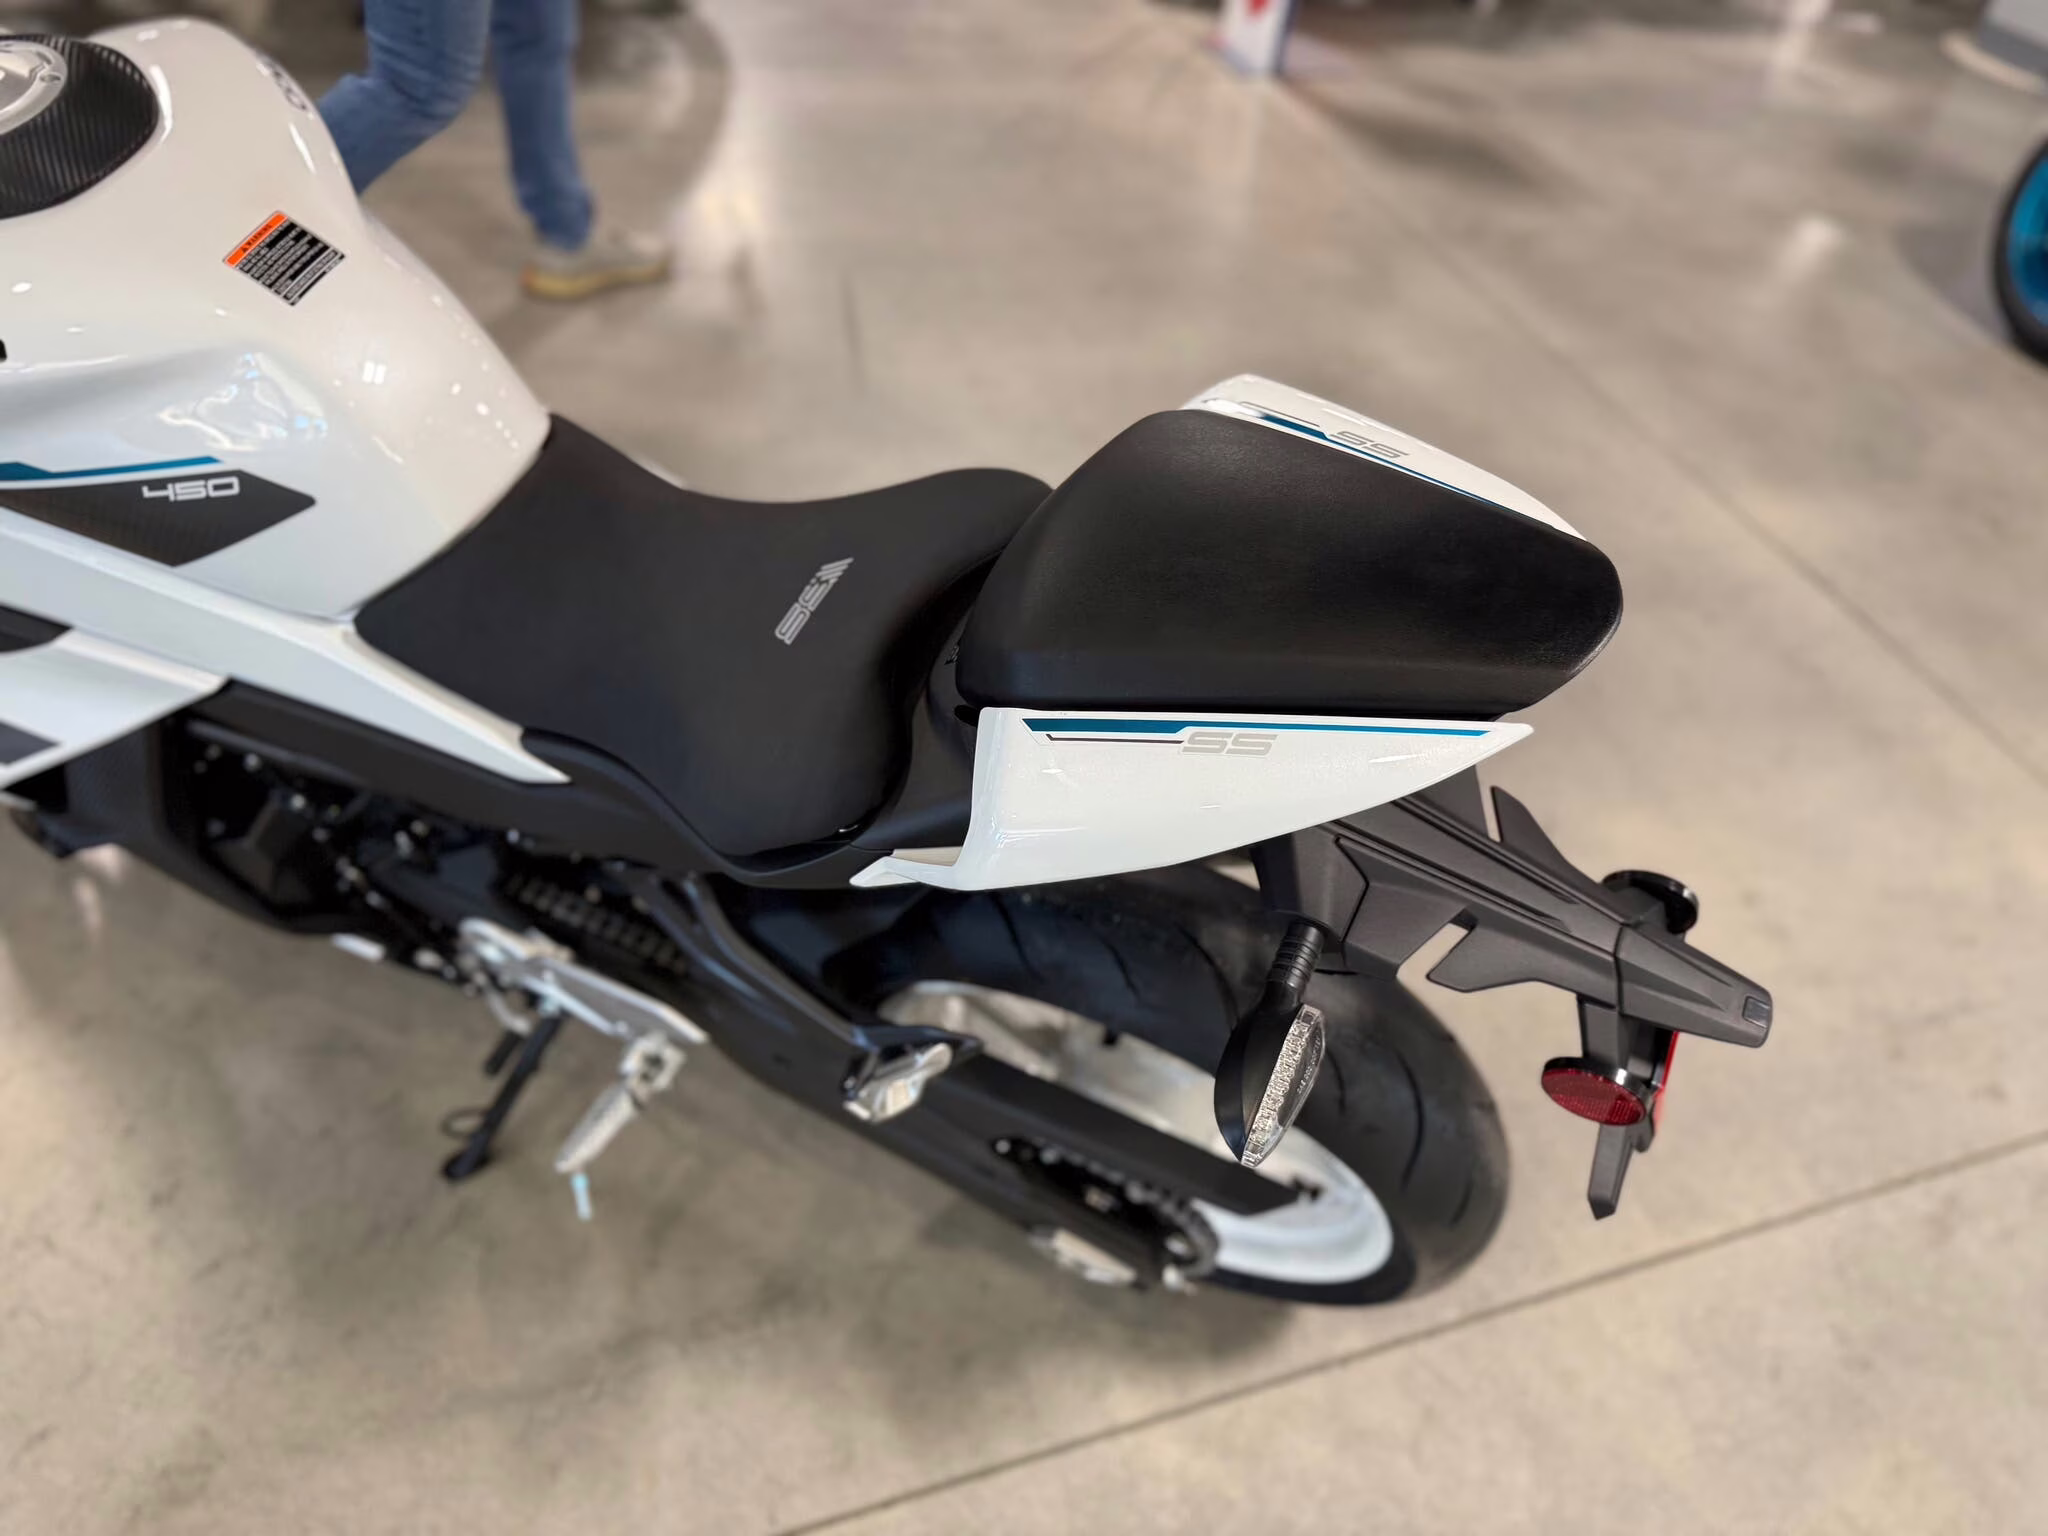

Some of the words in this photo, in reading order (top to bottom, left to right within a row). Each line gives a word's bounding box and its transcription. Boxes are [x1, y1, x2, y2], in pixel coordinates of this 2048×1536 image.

[1329, 430, 1410, 458] SS
[142, 476, 240, 502] 450
[1181, 731, 1279, 756] SS
